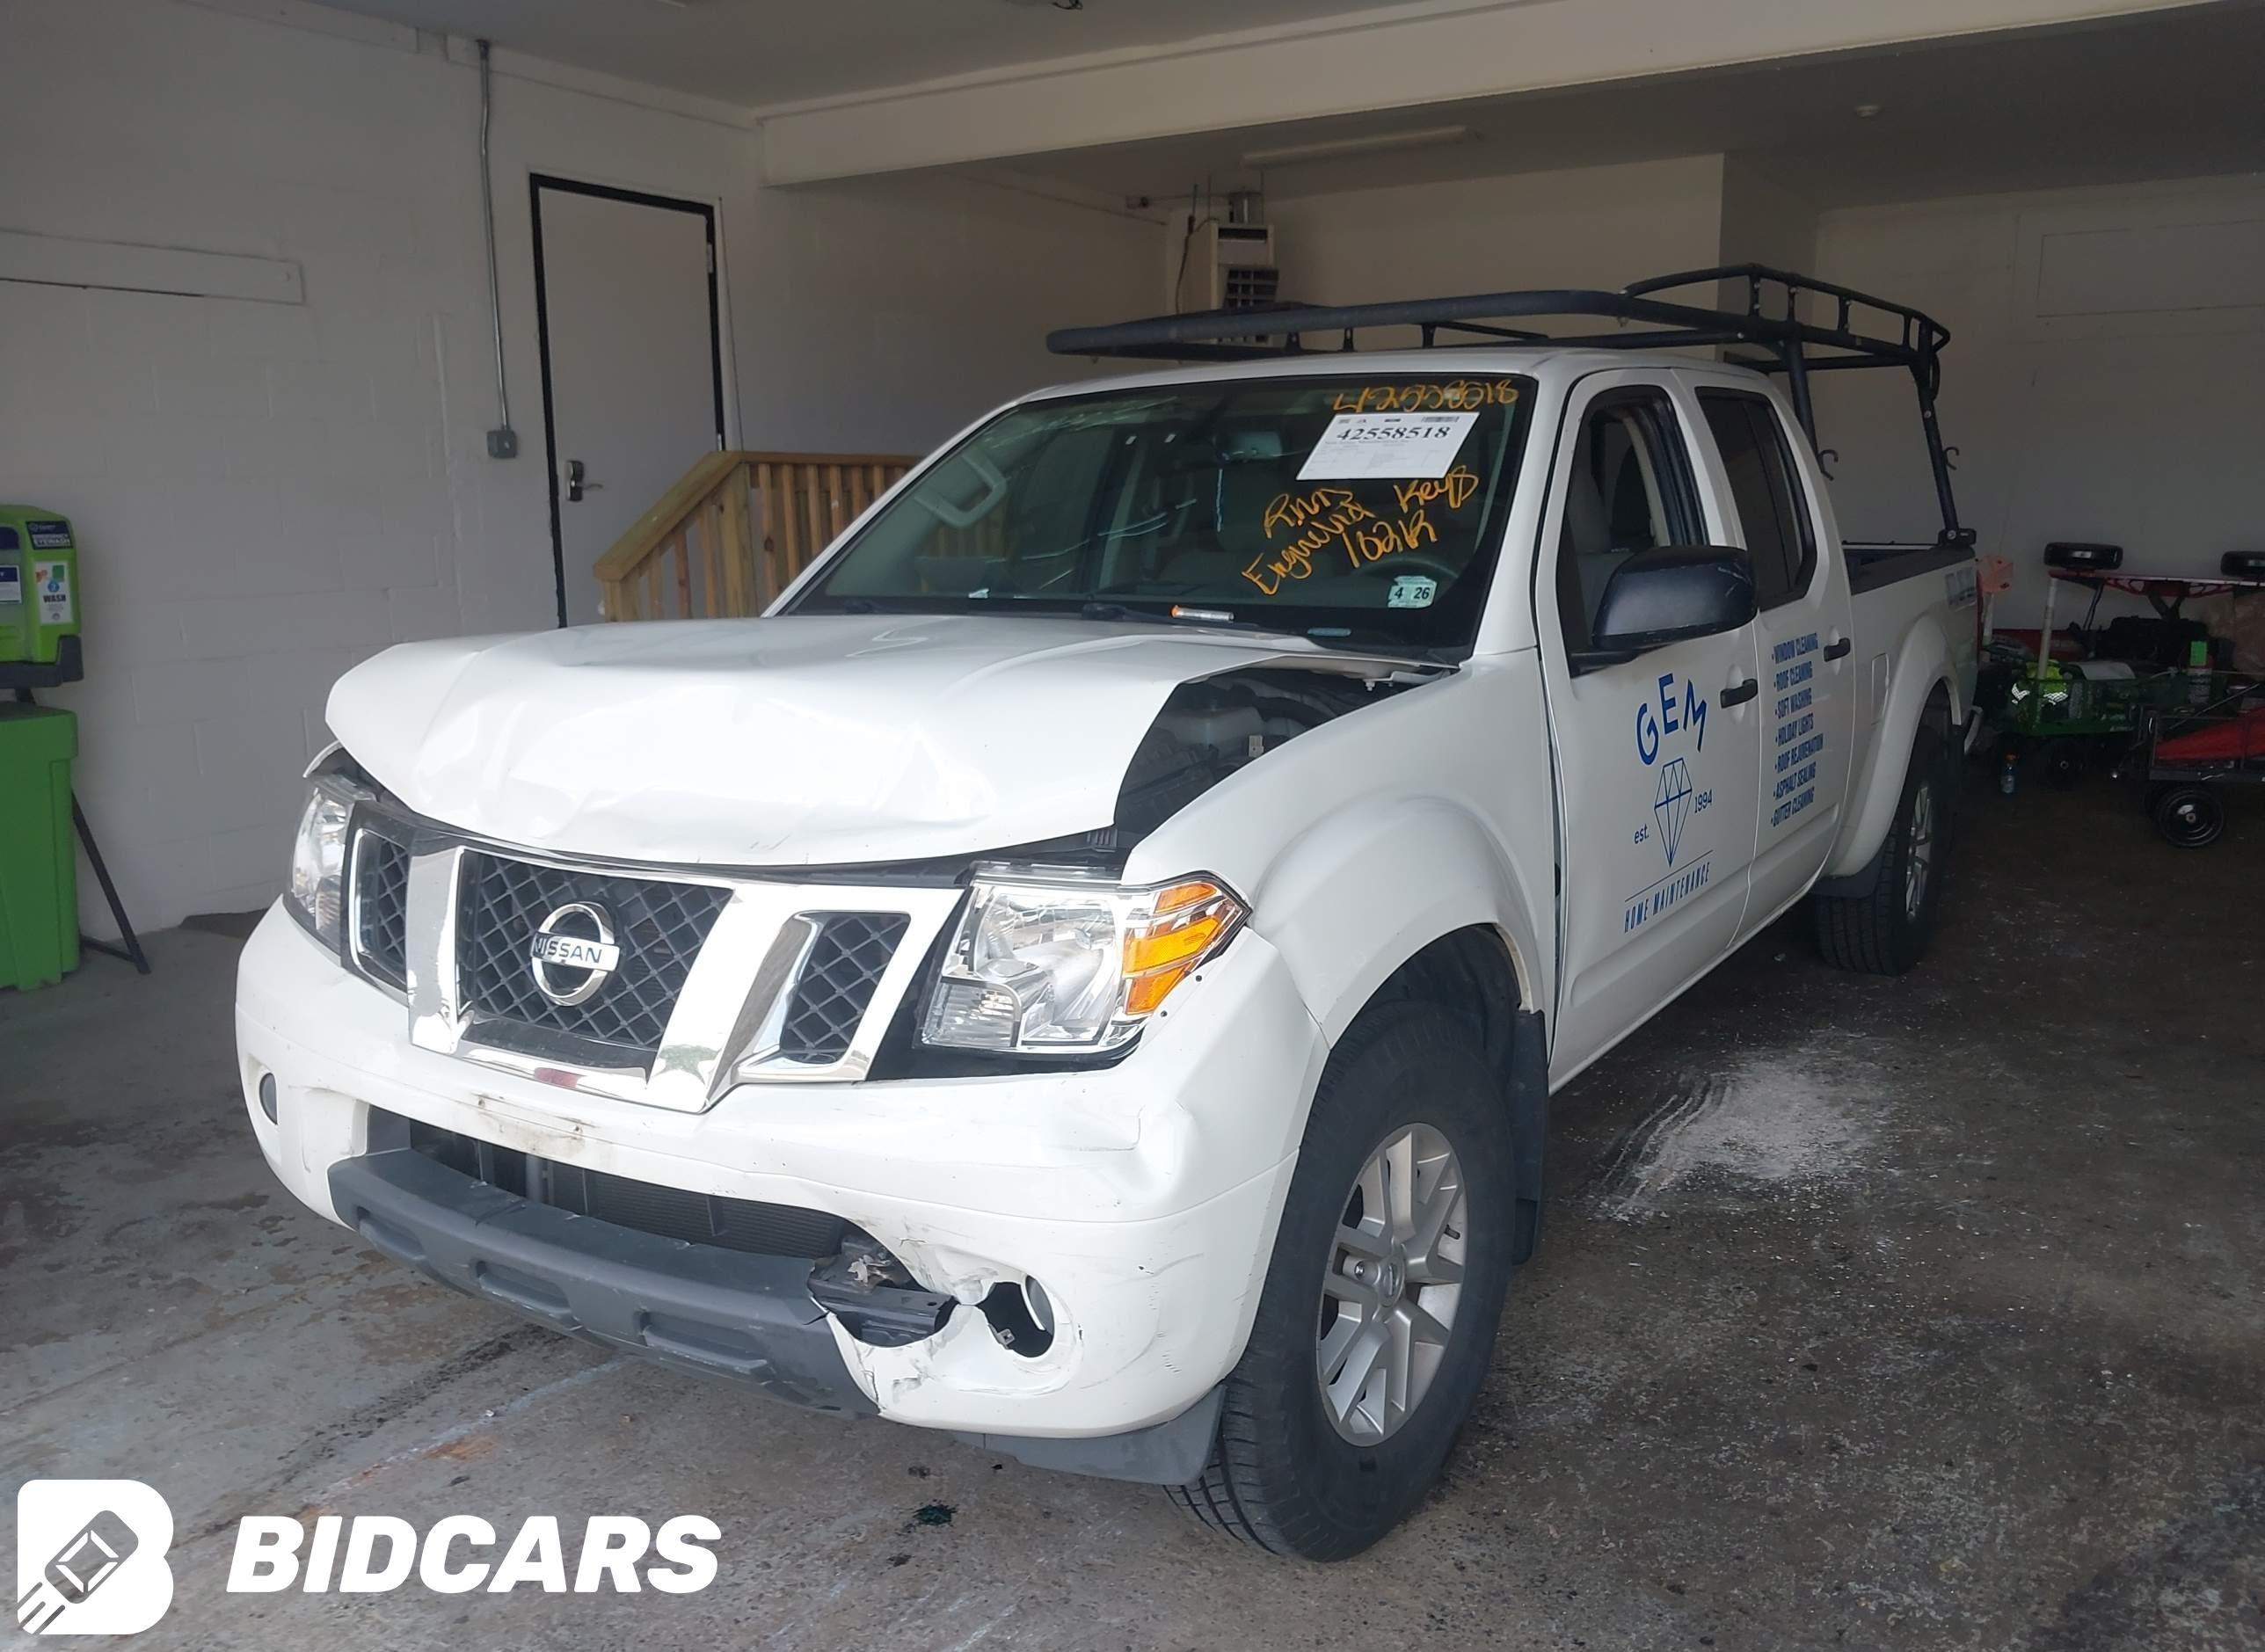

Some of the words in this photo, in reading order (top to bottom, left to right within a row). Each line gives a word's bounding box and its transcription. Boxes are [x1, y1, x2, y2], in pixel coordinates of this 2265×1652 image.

[1336, 426, 1452, 440] 42558518
[42, 593, 67, 603] WASH
[1394, 586, 1404, 600] 4
[1413, 586, 1431, 600] 26
[1636, 673, 1708, 767] GEM
[1693, 789, 1714, 814] 1994
[1633, 823, 1650, 845] est.
[1624, 899, 1650, 934] HOME
[1652, 862, 1710, 916] MAINTENANCE
[533, 936, 602, 964] NISSAN
